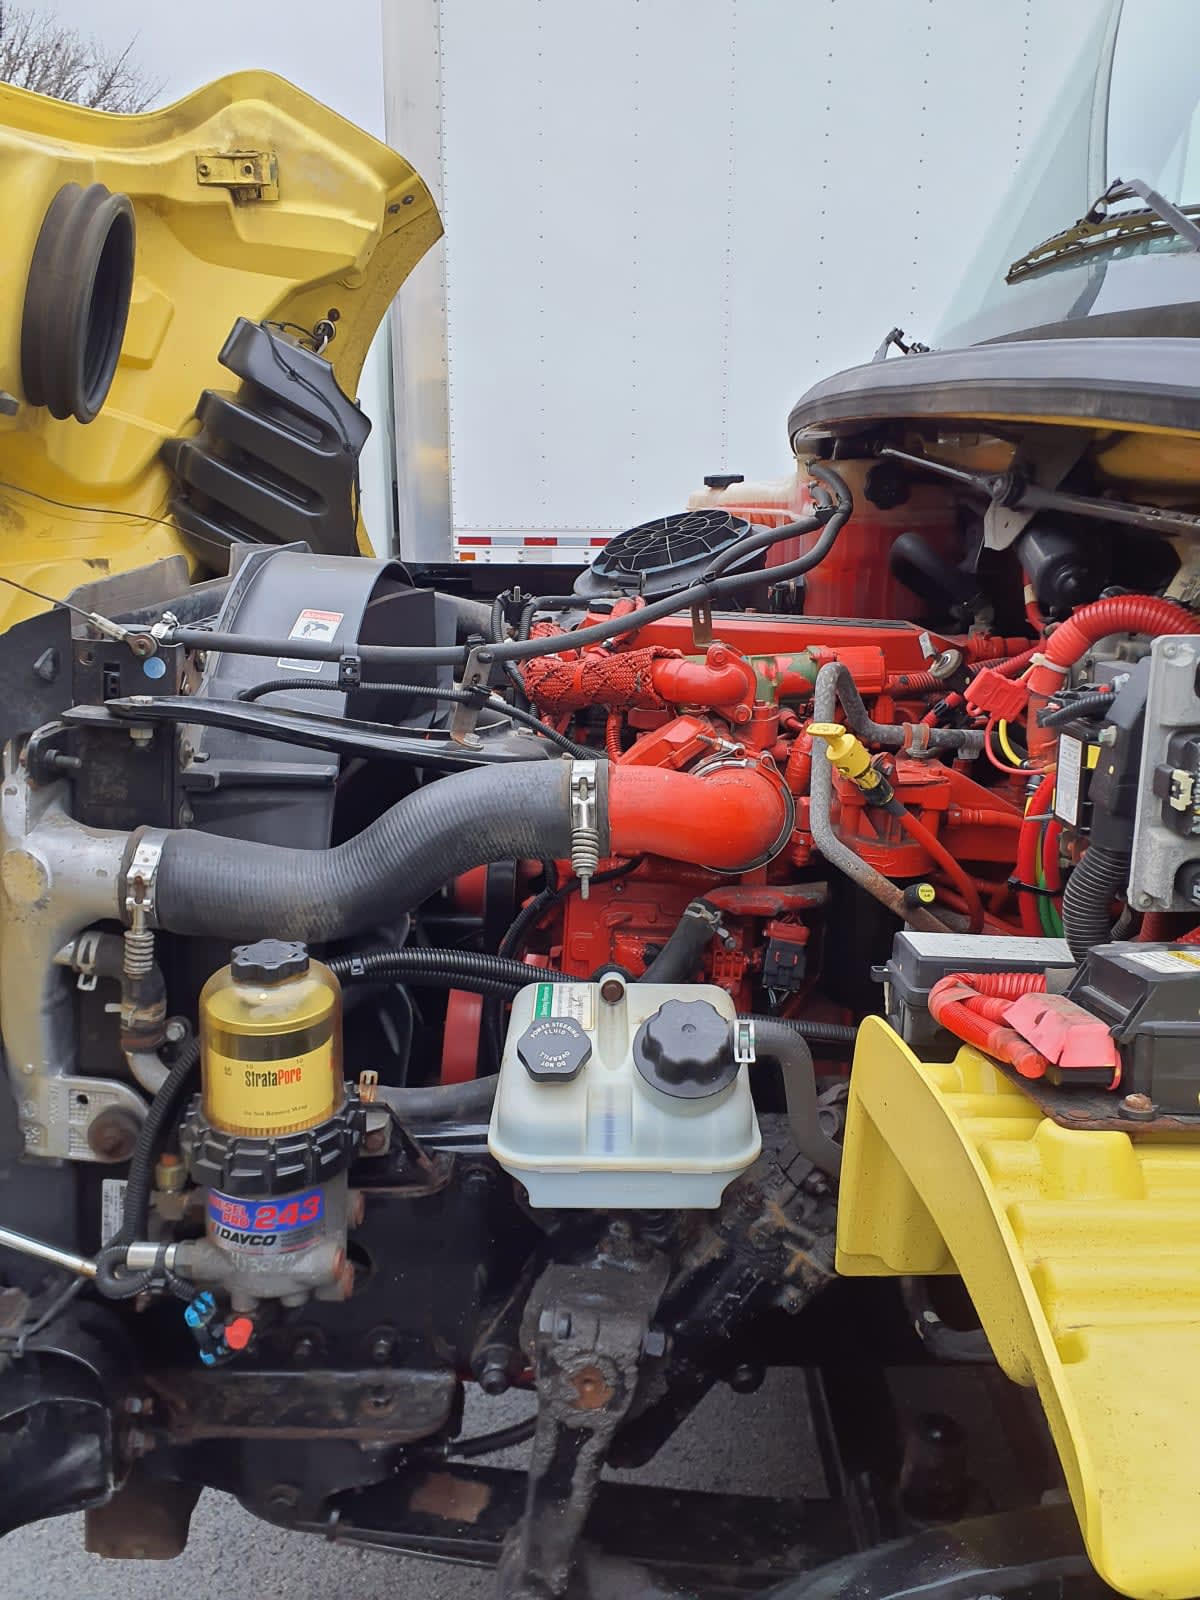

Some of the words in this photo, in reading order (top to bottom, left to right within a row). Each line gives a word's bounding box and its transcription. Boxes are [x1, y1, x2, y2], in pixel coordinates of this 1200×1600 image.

[530, 1022, 551, 1038] POWER
[552, 1022, 580, 1038] STEERING
[543, 1028, 567, 1036] FLUID
[539, 1051, 570, 1061] OVERFILL
[244, 1067, 302, 1087] StrataPore
[222, 1211, 250, 1230] PRO
[255, 1195, 320, 1230] 243
[220, 1227, 278, 1247] DAVCO
